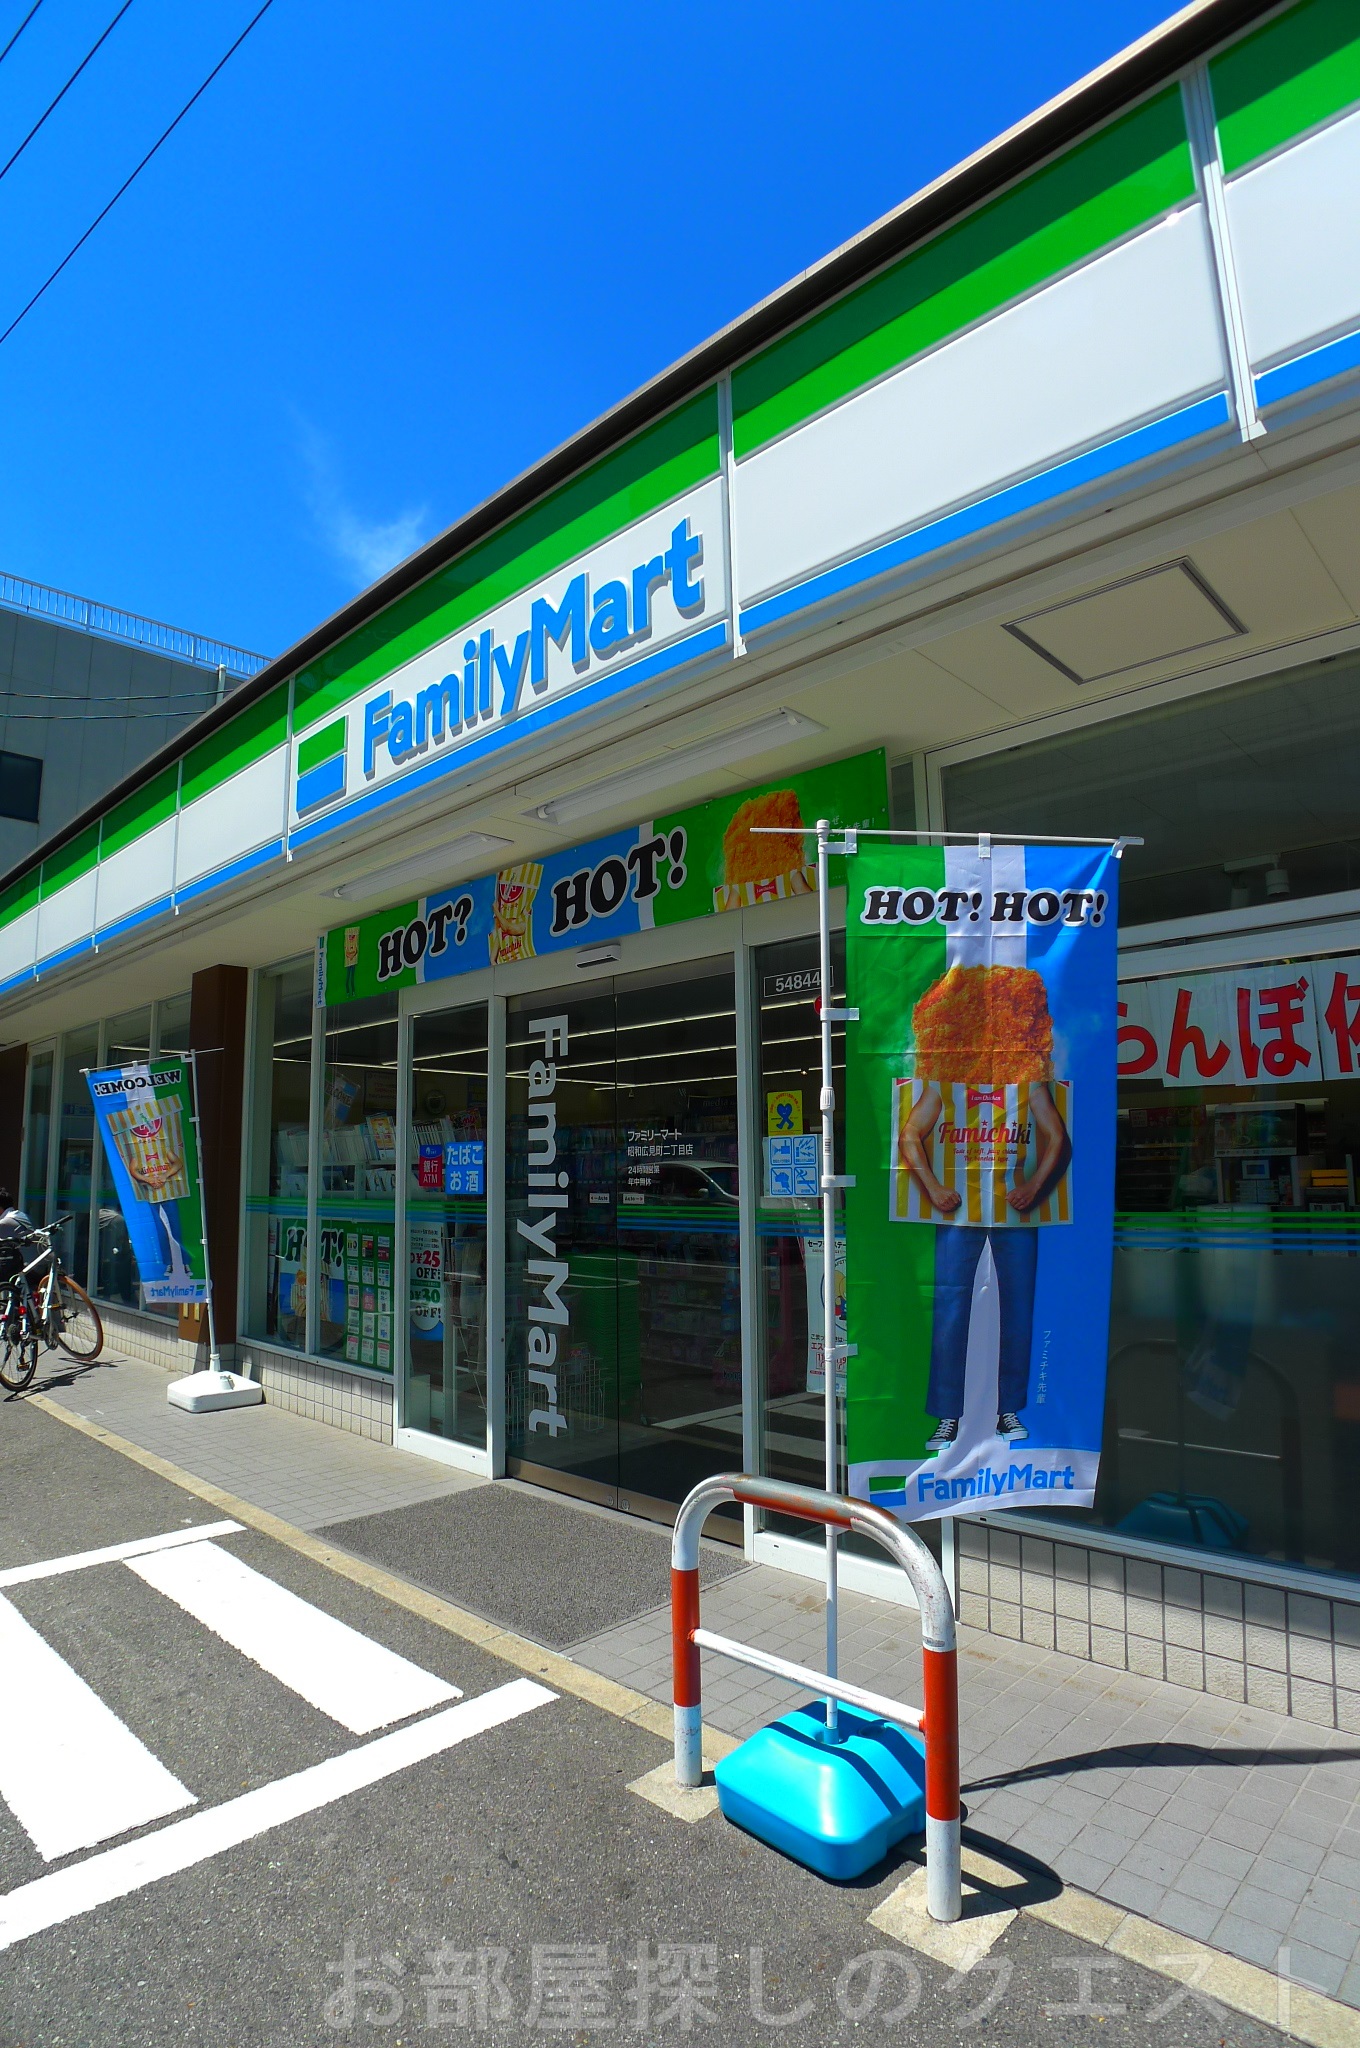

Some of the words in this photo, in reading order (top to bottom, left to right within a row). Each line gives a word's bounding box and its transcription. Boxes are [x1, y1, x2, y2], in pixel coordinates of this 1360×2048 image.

[363, 516, 704, 779] FamilyMart
[552, 830, 685, 933] HOT!
[865, 890, 982, 921] HOT!
[990, 892, 1104, 923] HOT!
[378, 897, 472, 978] HOT?
[775, 972, 821, 992] 54844
[627, 1128, 682, 1141] ファミリーマート
[938, 1119, 1032, 1145] Famichiki
[447, 1144, 483, 1166] たばこ
[627, 1144, 694, 1157] 昭和広見町二丁目店
[423, 1160, 438, 1173] 銀行
[627, 1164, 660, 1174] 24時間営業
[423, 1174, 438, 1184] ATM
[450, 1170, 479, 1192] お酒
[517, 1014, 569, 1437] FamilyMart
[284, 1228, 343, 1268] HT!
[917, 1463, 1075, 1502] FamilyMart
